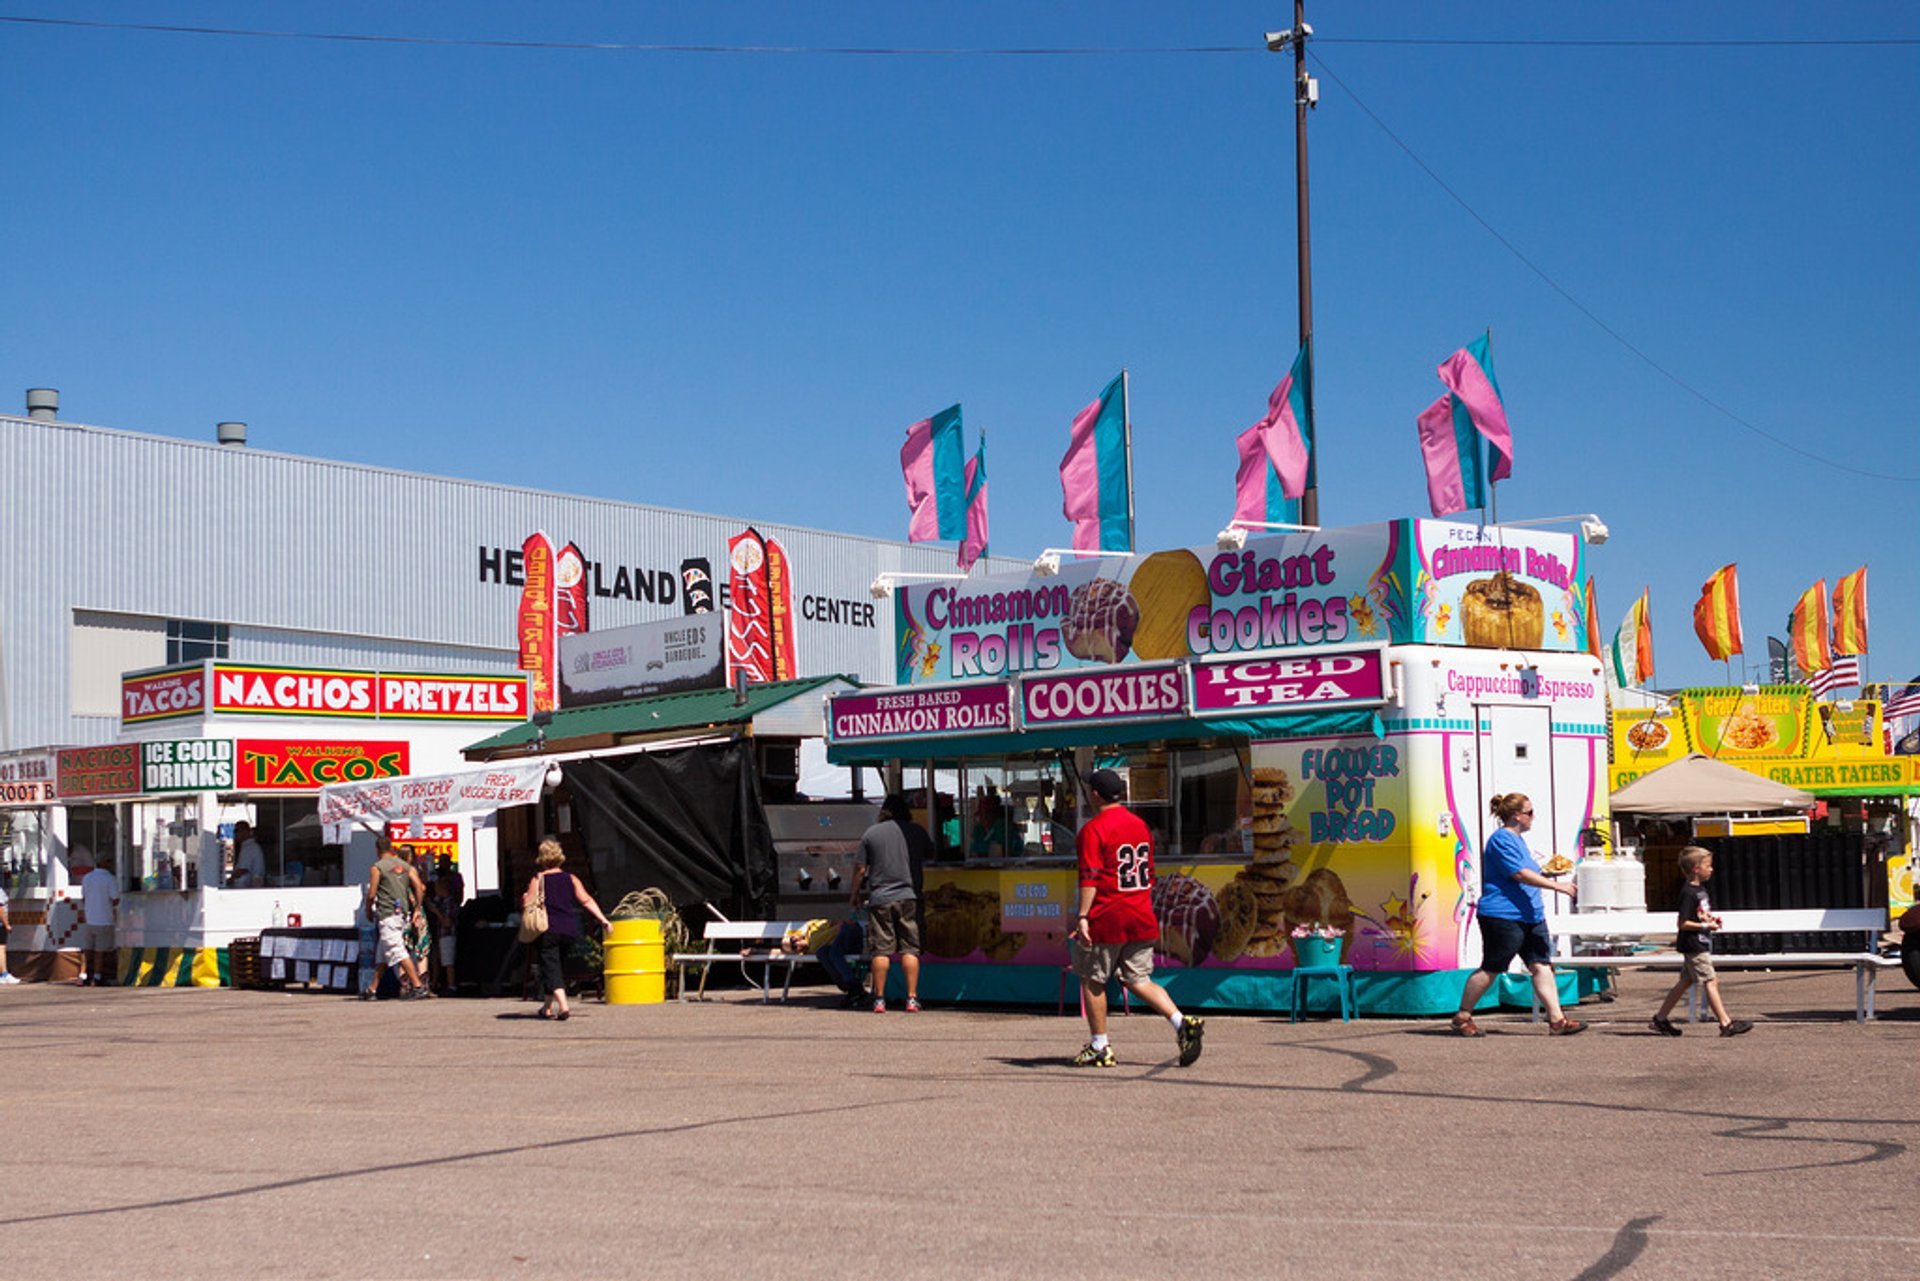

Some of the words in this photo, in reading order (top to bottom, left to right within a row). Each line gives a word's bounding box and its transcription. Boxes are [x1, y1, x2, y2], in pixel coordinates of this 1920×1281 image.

[1449, 528, 1492, 543] PECAN
[1209, 545, 1337, 596] Giant
[1432, 544, 1521, 581] Cinnamon
[1525, 546, 1571, 591] Rolls
[802, 594, 875, 628] CENTER
[924, 584, 1072, 631] Cinnamon
[1186, 593, 1348, 655] Cookies
[949, 622, 1063, 678] Rolls
[1208, 656, 1367, 684] ICED
[1447, 669, 1529, 698] Cappuccino
[1536, 674, 1596, 702] Espresso
[125, 679, 200, 716] TACOS
[219, 674, 370, 710] NACHOS
[383, 680, 519, 712] PRETZELS
[876, 693, 914, 711] FRESH
[918, 690, 961, 708] BAKED
[1029, 672, 1180, 719] COOKIES
[1225, 680, 1352, 707] TEA
[836, 708, 941, 738] CINNAMON
[945, 702, 1007, 730] ROLLS
[61, 747, 133, 770] NACHOS
[146, 742, 173, 763] ICE
[176, 740, 231, 762] COLD
[244, 751, 403, 785] TACOS
[1301, 744, 1401, 781] FLOWER
[18, 760, 48, 779] BEER
[61, 770, 135, 793] PRETZELS
[146, 761, 231, 789] DRINKS
[485, 772, 516, 787] FRESH
[1769, 766, 1834, 785] GRATER
[1838, 764, 1902, 782] TATERS
[1326, 777, 1376, 811] POT
[1309, 807, 1397, 844] BREAD
[1116, 842, 1153, 892] 22
